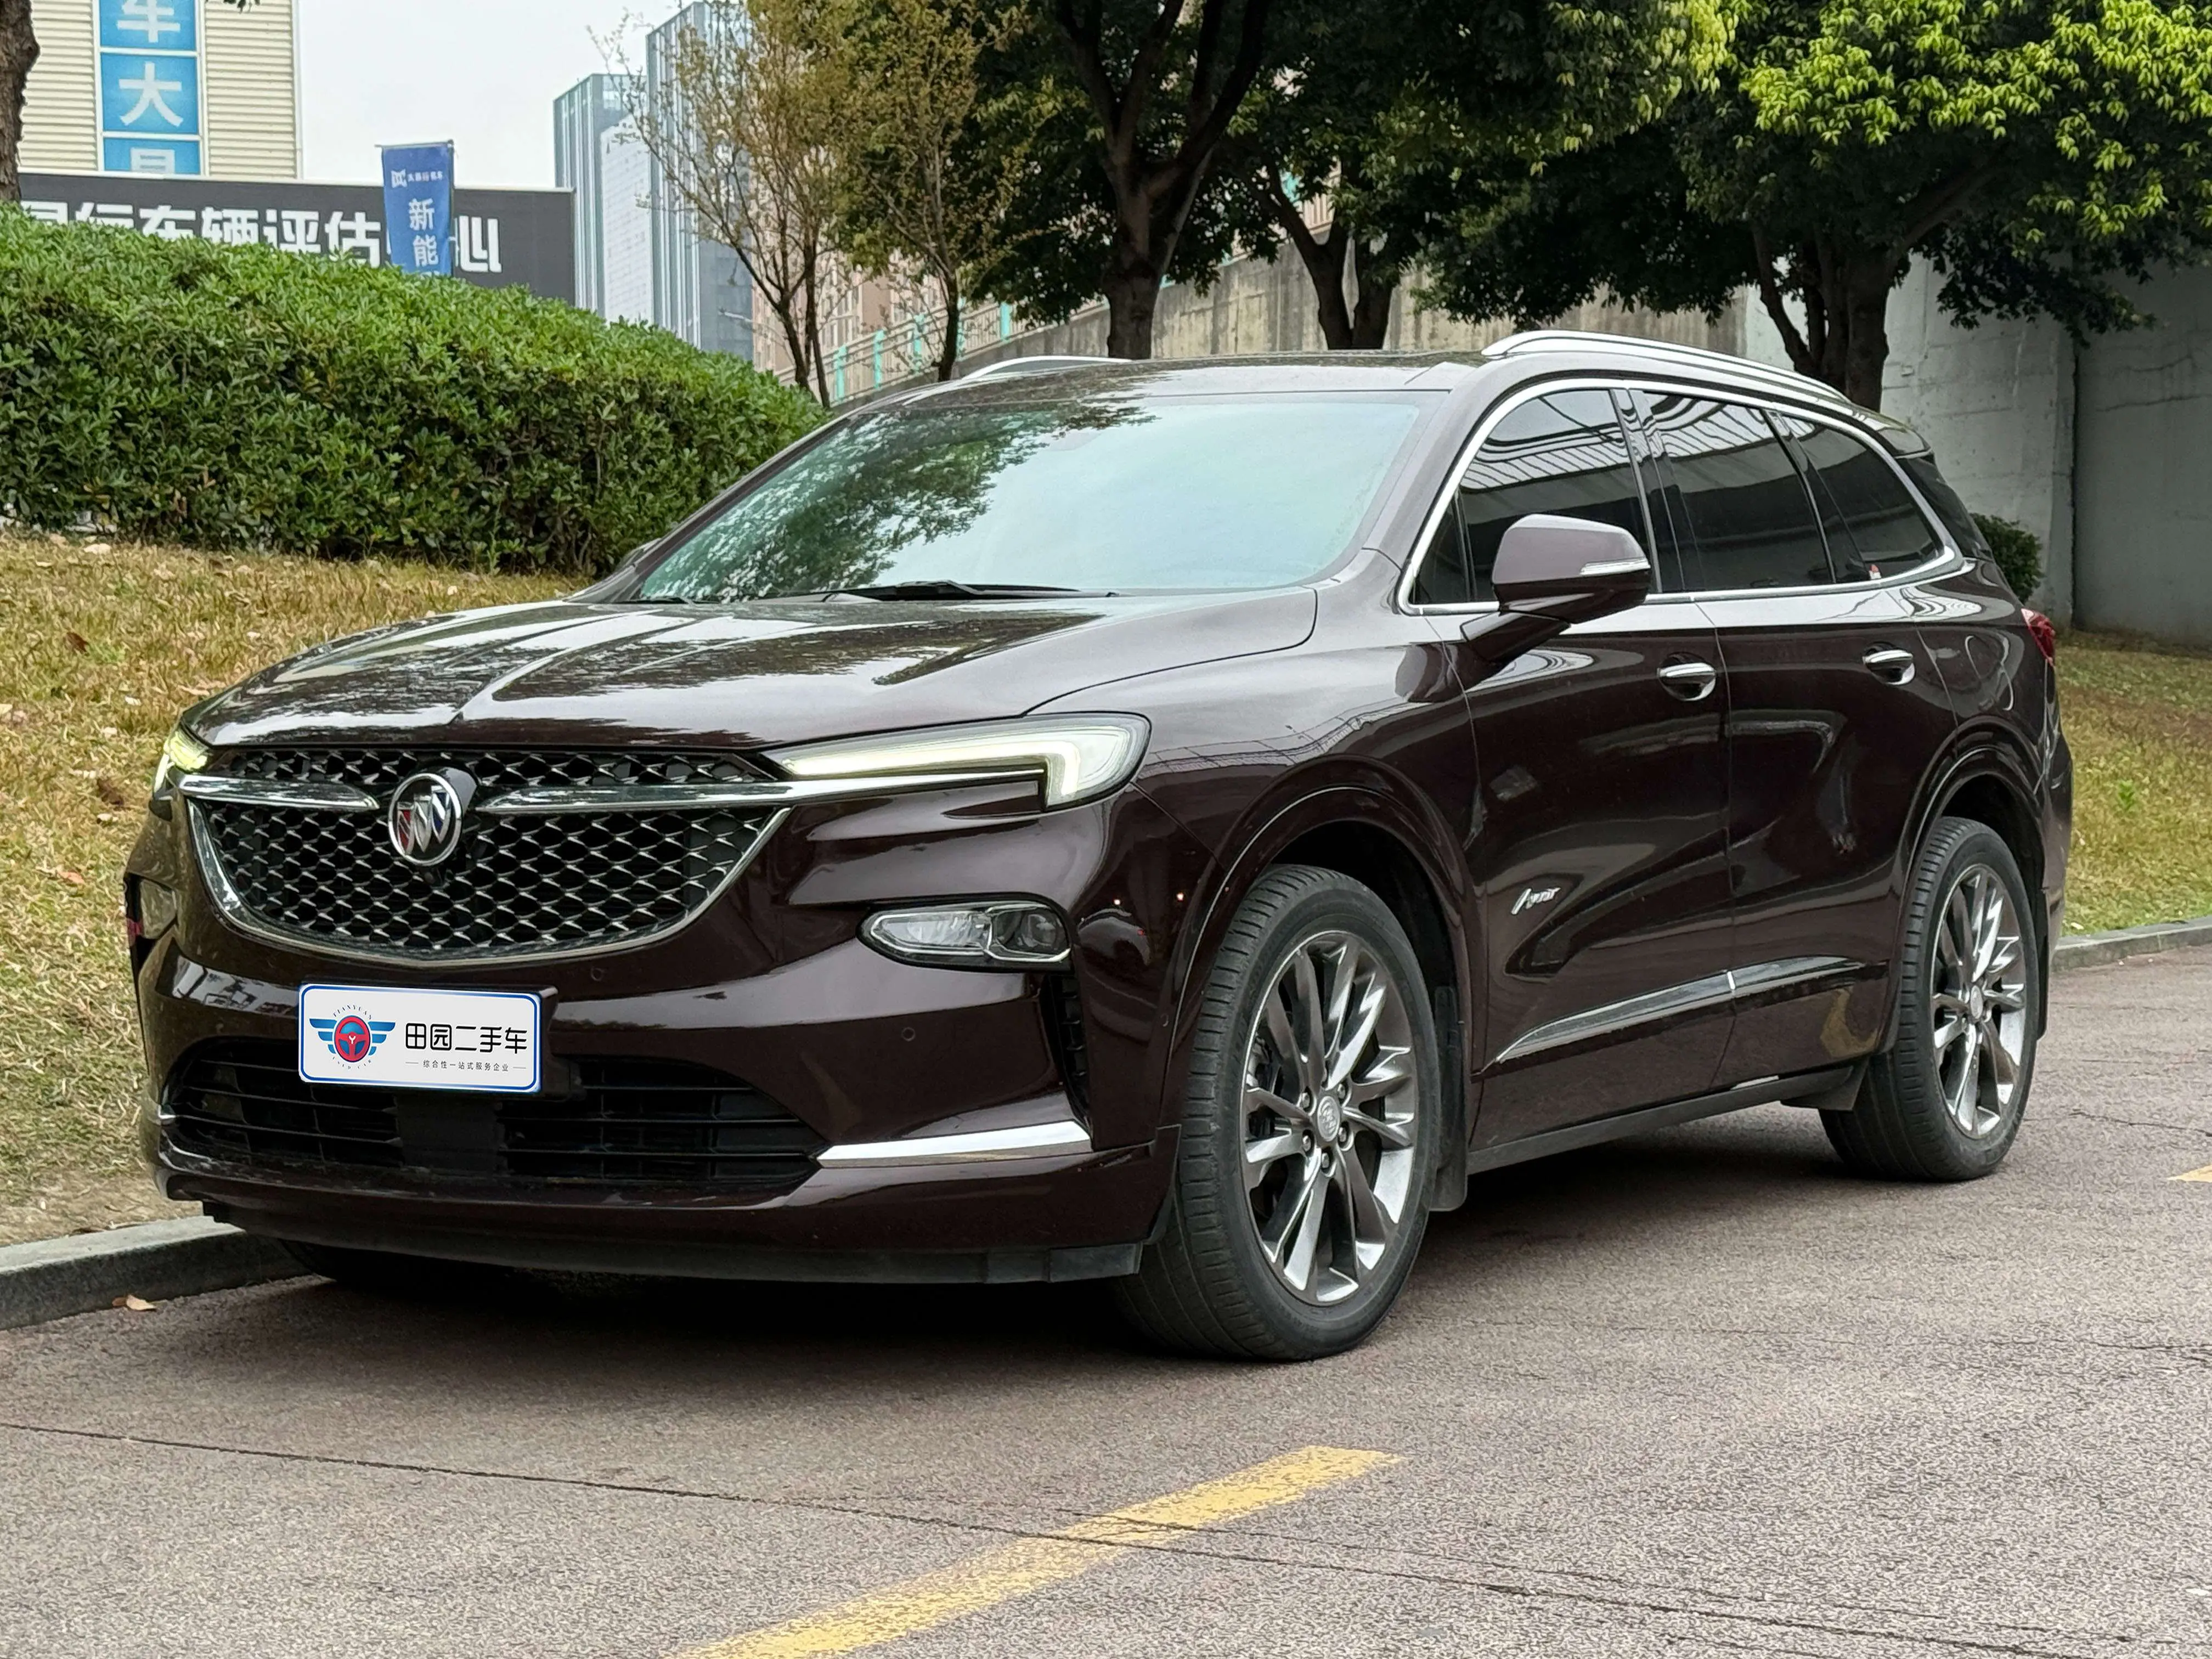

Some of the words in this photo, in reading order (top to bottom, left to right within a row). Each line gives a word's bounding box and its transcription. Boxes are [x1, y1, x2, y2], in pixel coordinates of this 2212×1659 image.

[408, 198, 439, 276] 新能
[405, 1023, 527, 1054] 田园二手车
[423, 1059, 509, 1072] 综合性一站式服务企业
